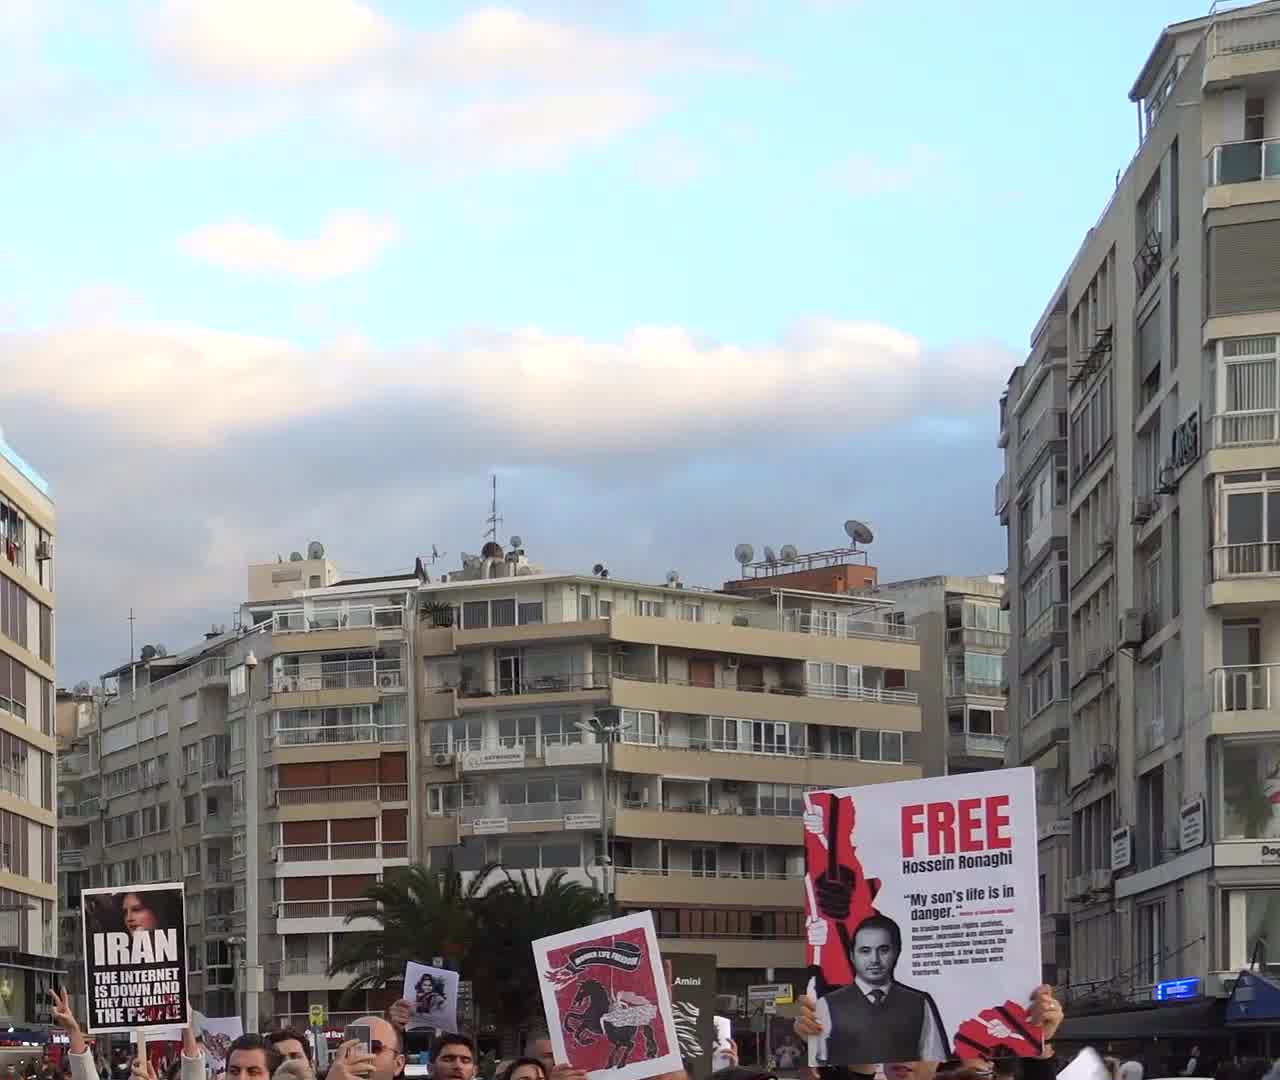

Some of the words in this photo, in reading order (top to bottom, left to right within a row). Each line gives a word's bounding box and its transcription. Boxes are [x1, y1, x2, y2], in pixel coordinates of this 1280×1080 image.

[901, 795, 1012, 858] FREE
[902, 856, 955, 874] Hossein
[959, 849, 1013, 869] Ronaghi
[931, 889, 964, 905] son's
[966, 887, 985, 901] life
[988, 885, 1000, 900] is
[1002, 884, 1014, 898] in
[93, 928, 178, 967] IRAN
[93, 971, 118, 985] THE
[119, 967, 180, 983] INTERNET
[673, 976, 701, 986] Amini
[94, 985, 109, 998] IS
[110, 983, 151, 997] DOWN
[152, 981, 180, 995] AND
[94, 997, 119, 1008] THEY
[121, 996, 141, 1007] ARE
[95, 1008, 125, 1024] THE
